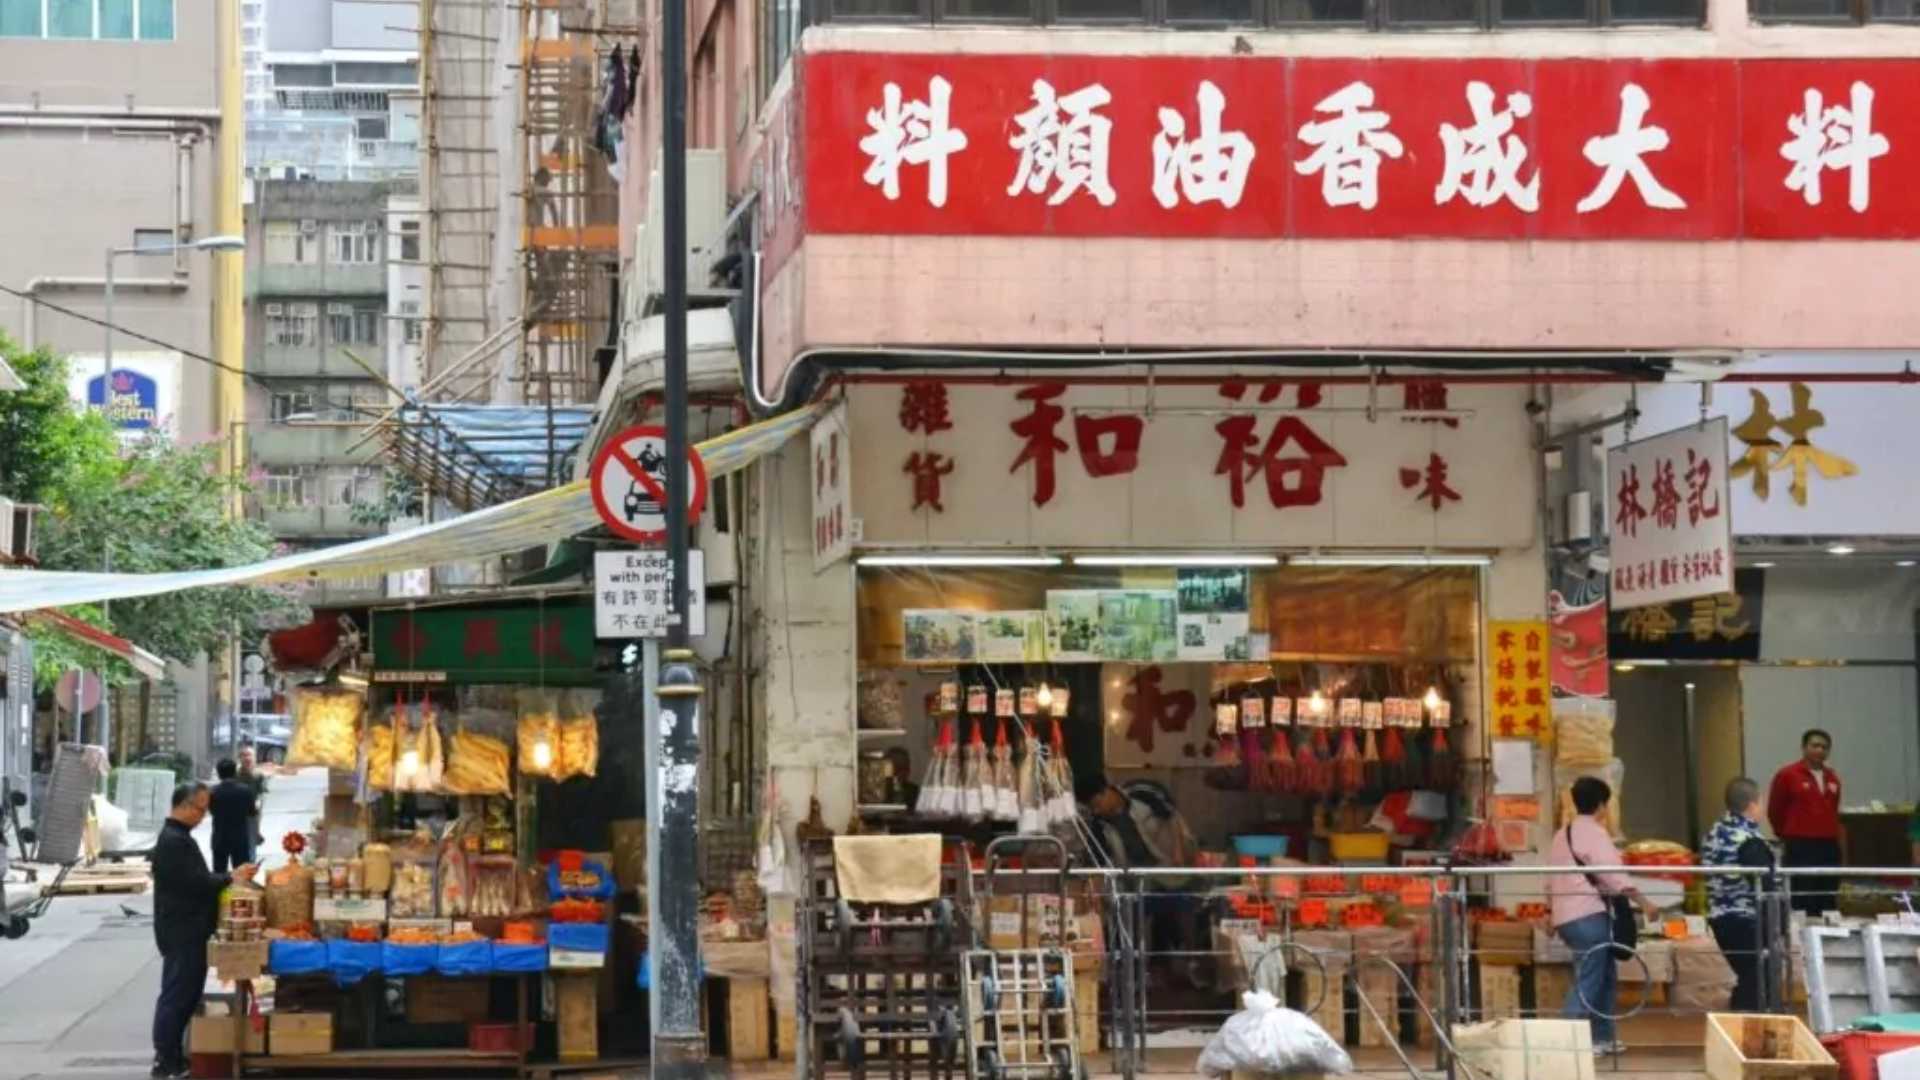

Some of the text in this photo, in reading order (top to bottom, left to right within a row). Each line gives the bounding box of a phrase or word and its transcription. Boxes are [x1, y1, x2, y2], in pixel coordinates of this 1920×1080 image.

[1780, 81, 1890, 213] 料
[1729, 382, 1860, 507] 林
[1615, 447, 1720, 538] 林橋記
[609, 571, 640, 582] with
[626, 555, 669, 570] Excep
